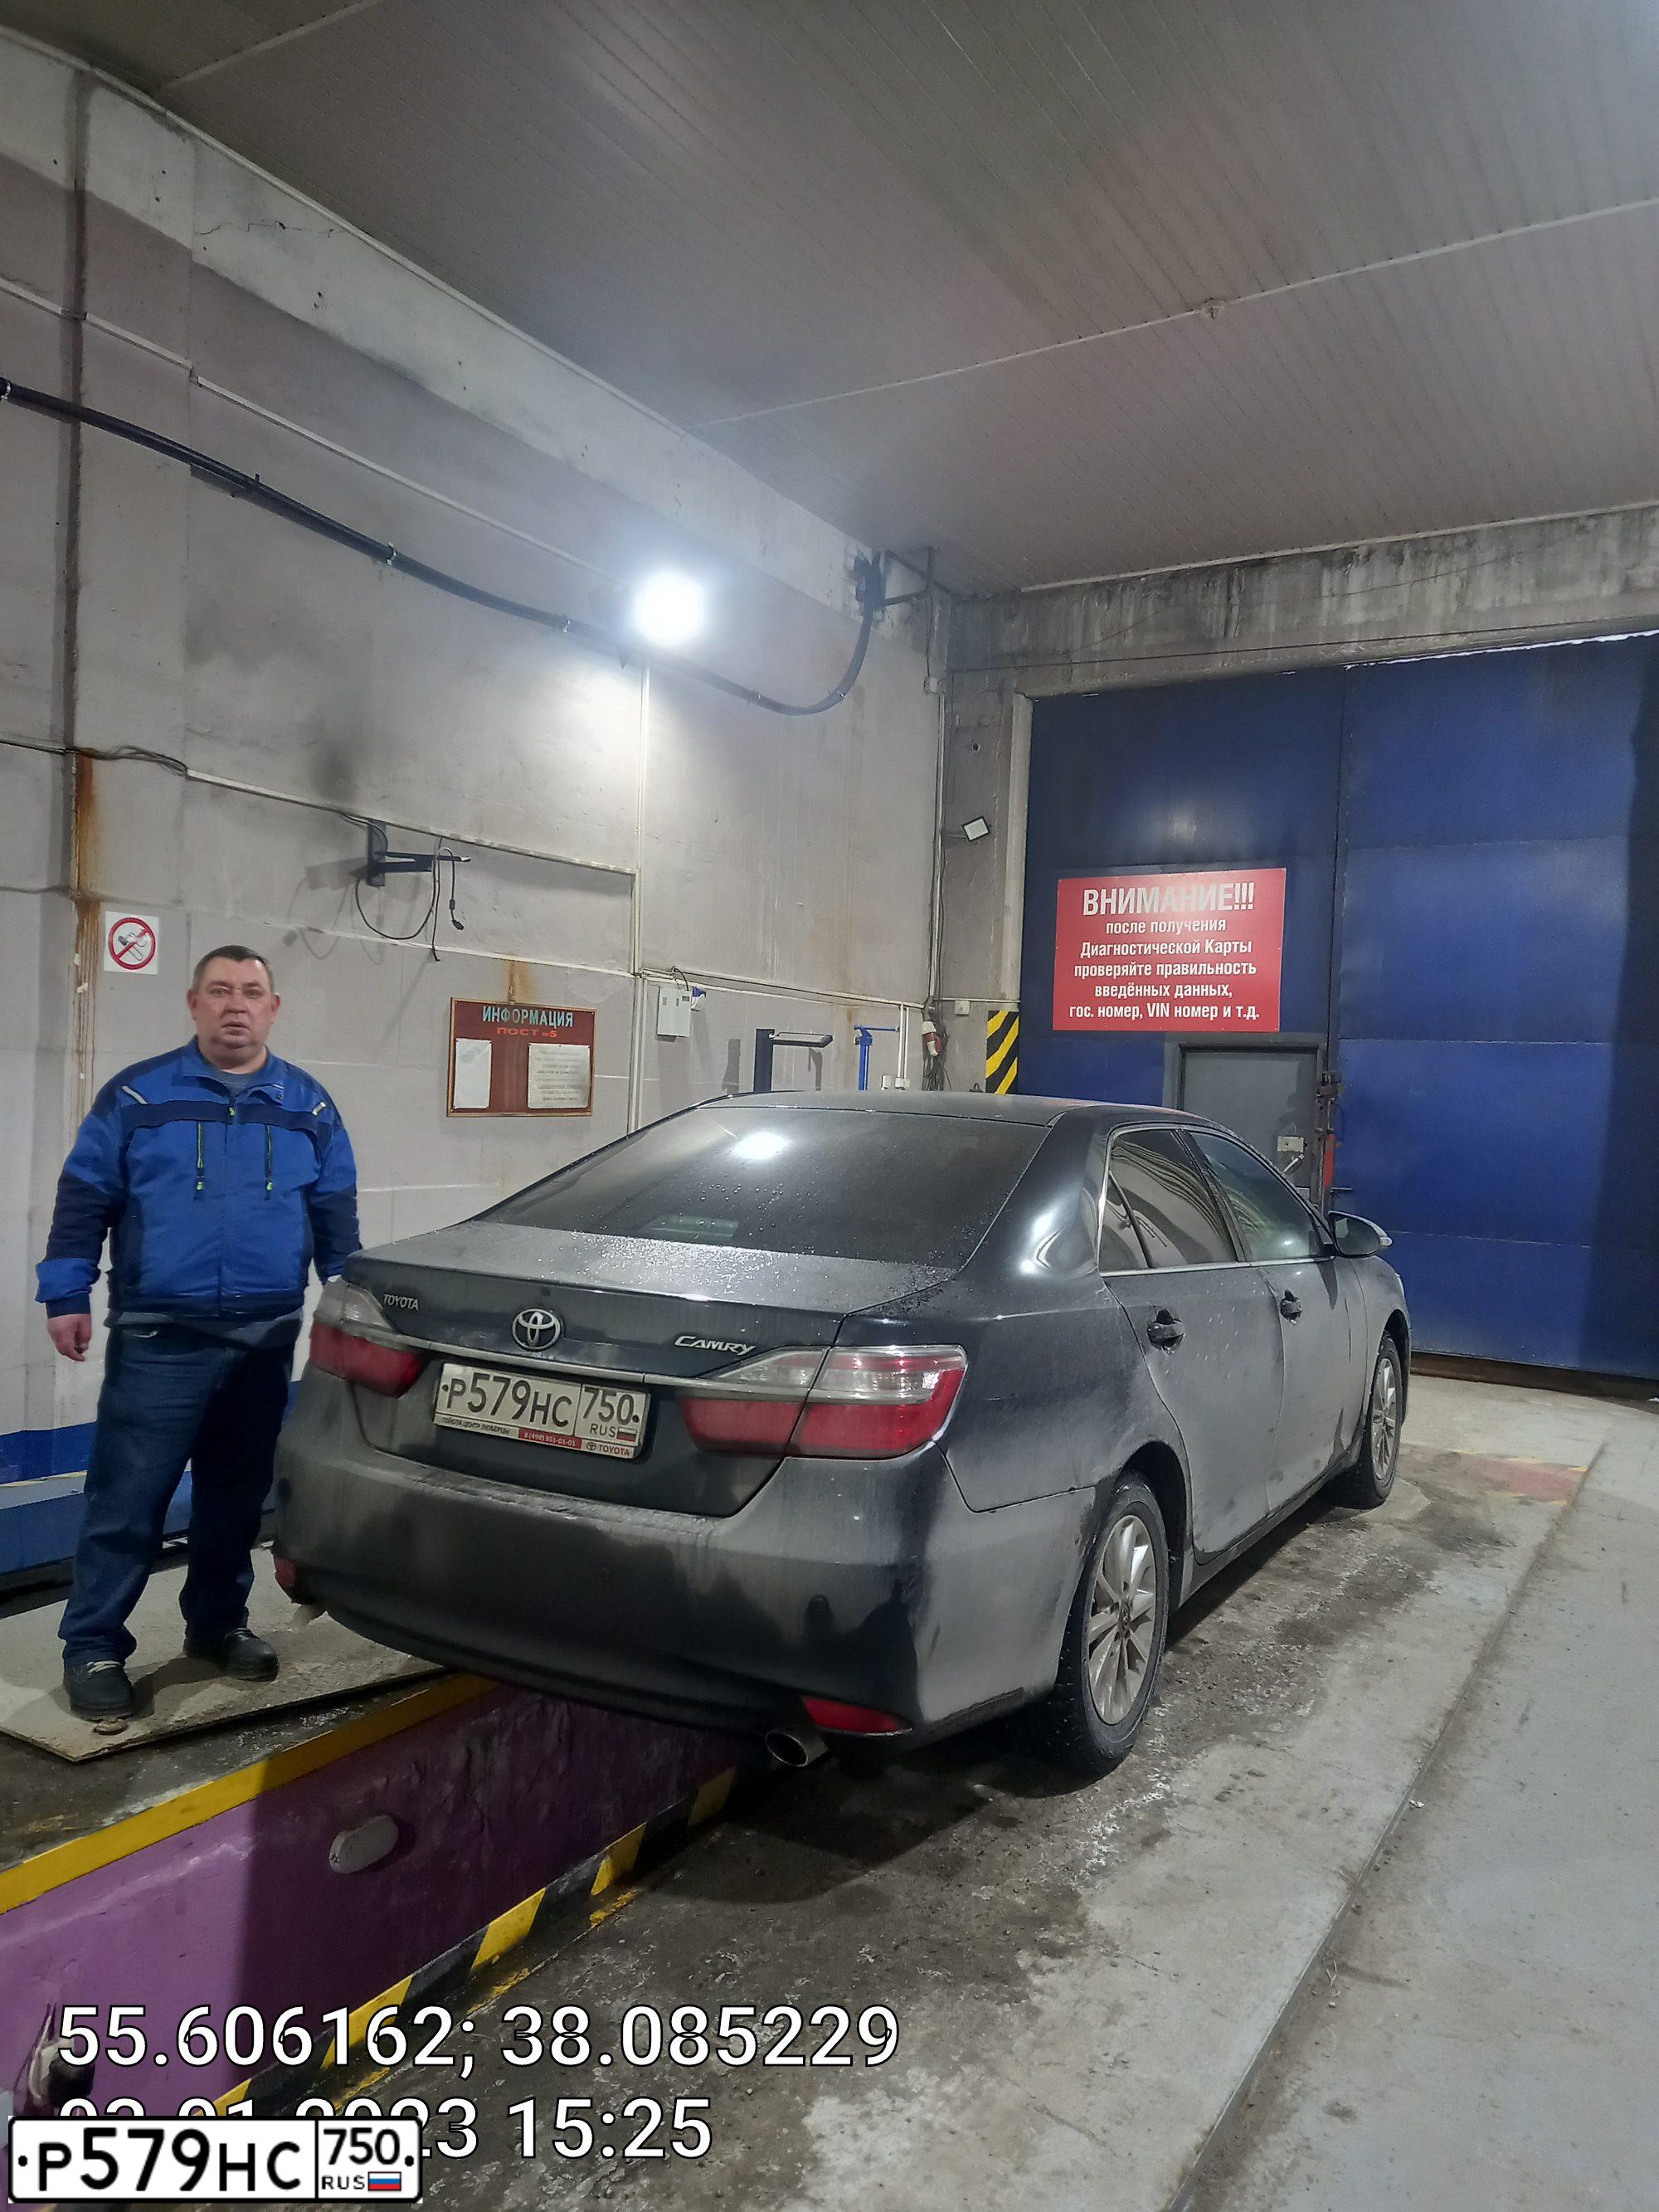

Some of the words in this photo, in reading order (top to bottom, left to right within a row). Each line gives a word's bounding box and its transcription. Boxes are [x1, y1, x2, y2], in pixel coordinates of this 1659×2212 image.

[1082, 882, 1255, 916] ВНИМАНИЕ!!!
[1106, 921, 1146, 934] после
[1151, 918, 1227, 935] получения
[1080, 939, 1200, 958] Диагностической
[1204, 939, 1252, 956] Карты
[1074, 962, 1152, 979] проверяйте
[1156, 962, 1257, 977] правильность
[1095, 983, 1170, 997] введённых
[1175, 983, 1233, 998] данных,
[482, 1006, 573, 1029] ИНФОРМАЦИЯ
[1069, 1006, 1094, 1018] гос.
[1097, 1004, 1143, 1021] номер,
[1146, 1003, 1170, 1018] VIN
[1174, 1004, 1219, 1019] номер
[1223, 1004, 1232, 1017] и
[1236, 1004, 1260, 1020] т.д.
[384, 1294, 418, 1310] TOYOTA
[674, 1335, 757, 1356] CAMRY
[582, 1386, 634, 1425] 750
[590, 1423, 616, 1438] RUS
[599, 1445, 630, 1457] TOYOTA
